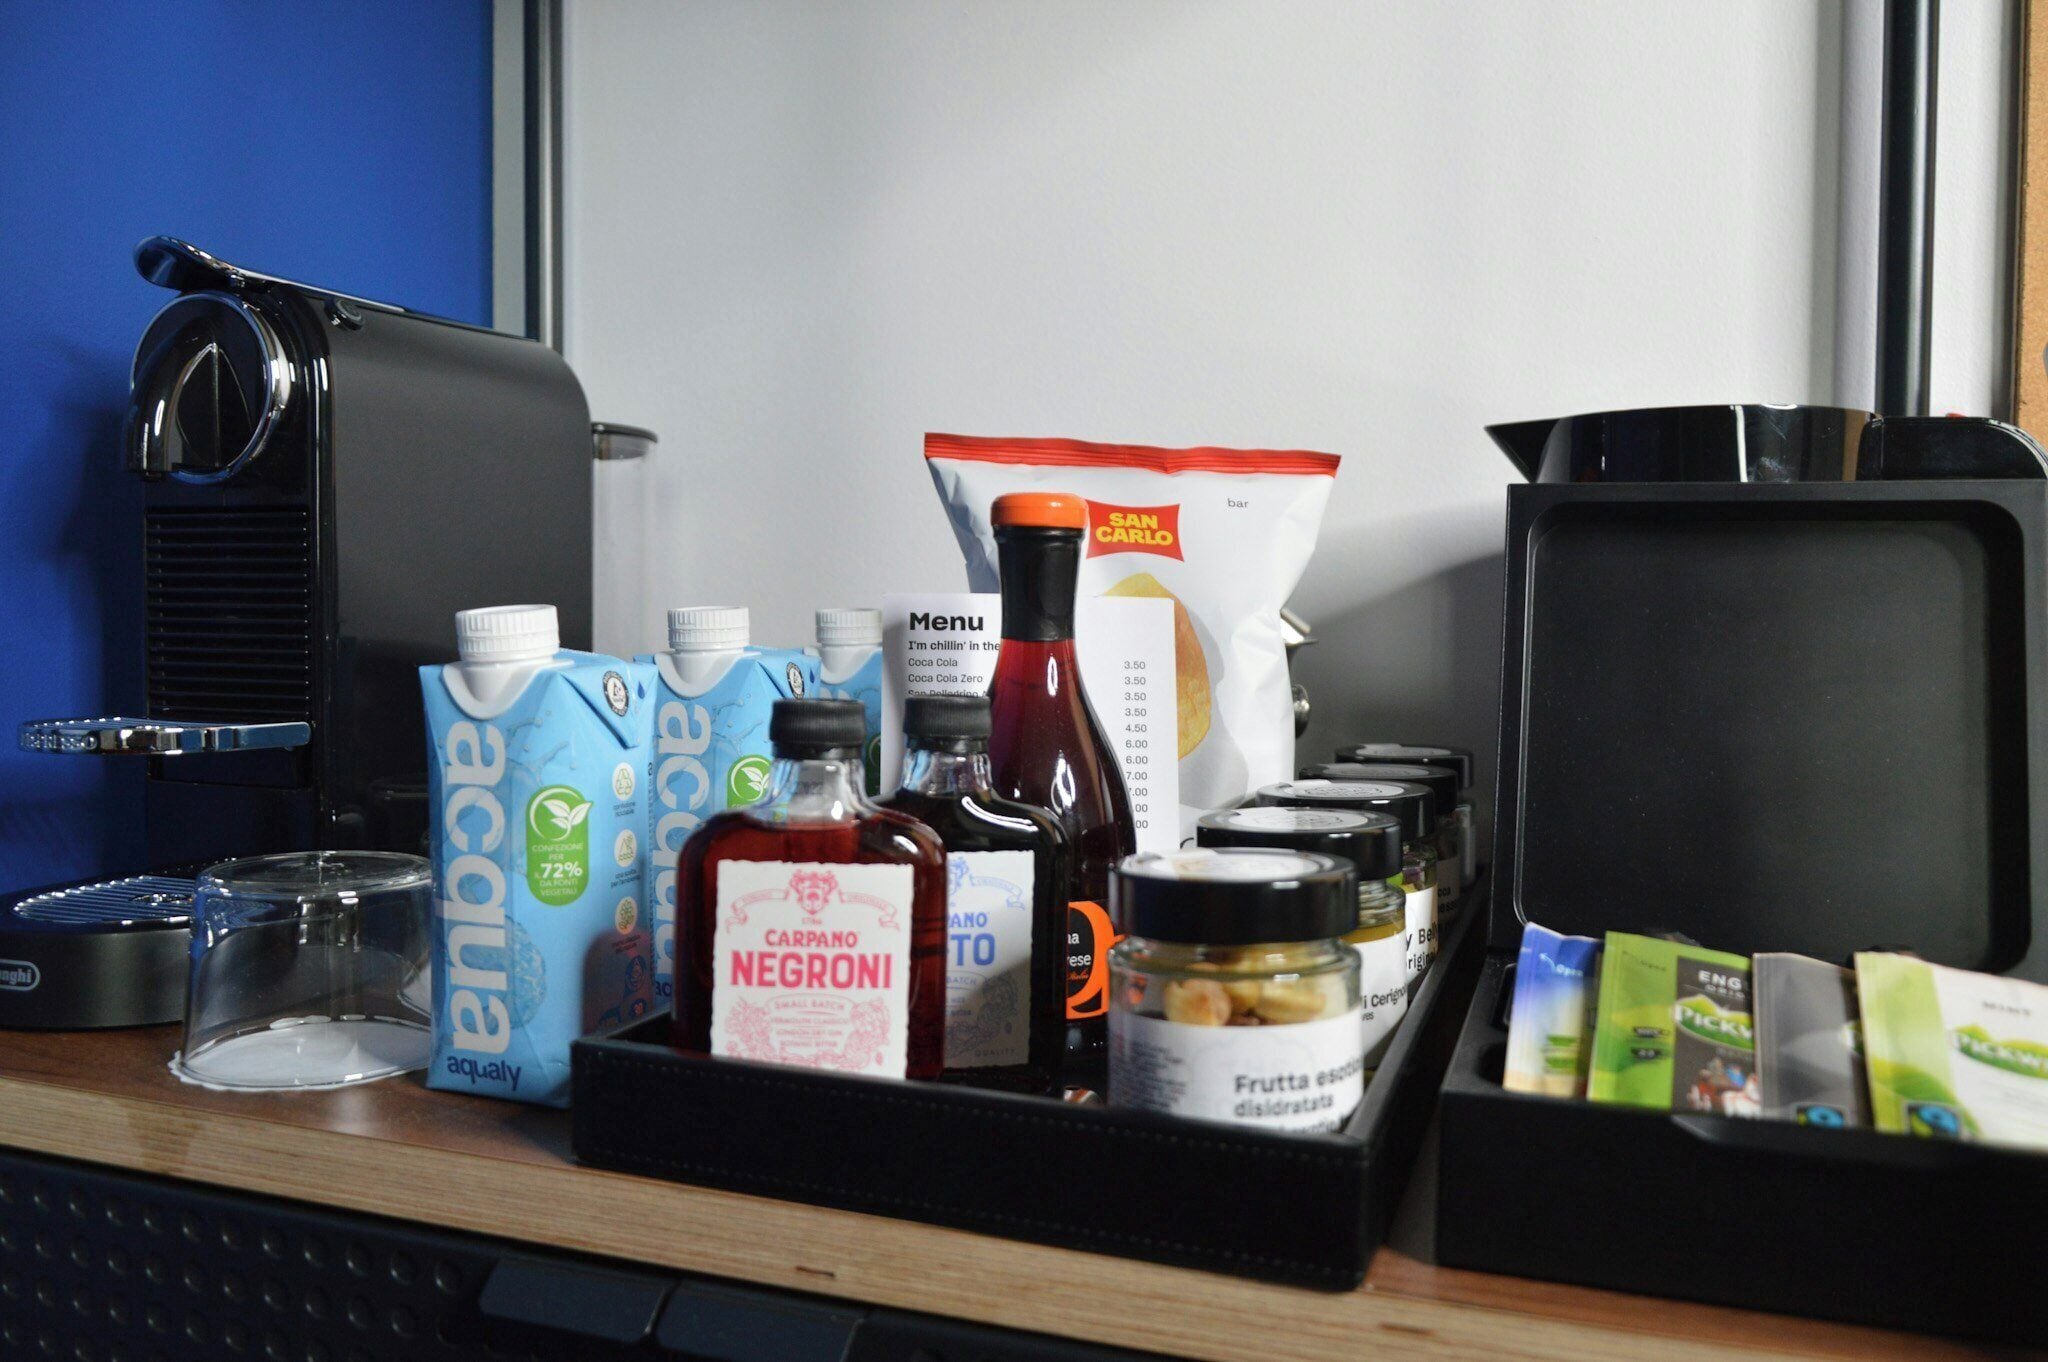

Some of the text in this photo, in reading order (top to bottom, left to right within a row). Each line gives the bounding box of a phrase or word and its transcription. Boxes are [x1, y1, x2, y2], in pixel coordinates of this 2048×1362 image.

[1228, 498, 1249, 508] bar
[1109, 512, 1159, 530] SAN
[1096, 526, 1174, 546] CARLO
[910, 612, 984, 631] Menu
[908, 641, 1000, 651] I'm chillin' in the
[908, 658, 958, 667] Coca Cola
[1124, 660, 1146, 669] 3.50
[908, 674, 983, 683] Coca Cola Zero
[1124, 676, 1147, 685] 3.50
[1124, 692, 1147, 701] 3.50
[1125, 708, 1147, 717] 3.50
[1125, 724, 1148, 733] 4.50
[1126, 739, 1149, 748] 6.00
[1126, 755, 1149, 764] 6.00
[1126, 771, 1148, 780] 7.00
[540, 861, 583, 879] 72%
[440, 721, 511, 1054] acqua
[765, 929, 858, 947] CARPANO
[731, 952, 892, 989] NEGRONI
[775, 1000, 808, 1010] SMALL
[447, 1056, 521, 1091] aqualy
[1235, 1072, 1309, 1093] Frutta
